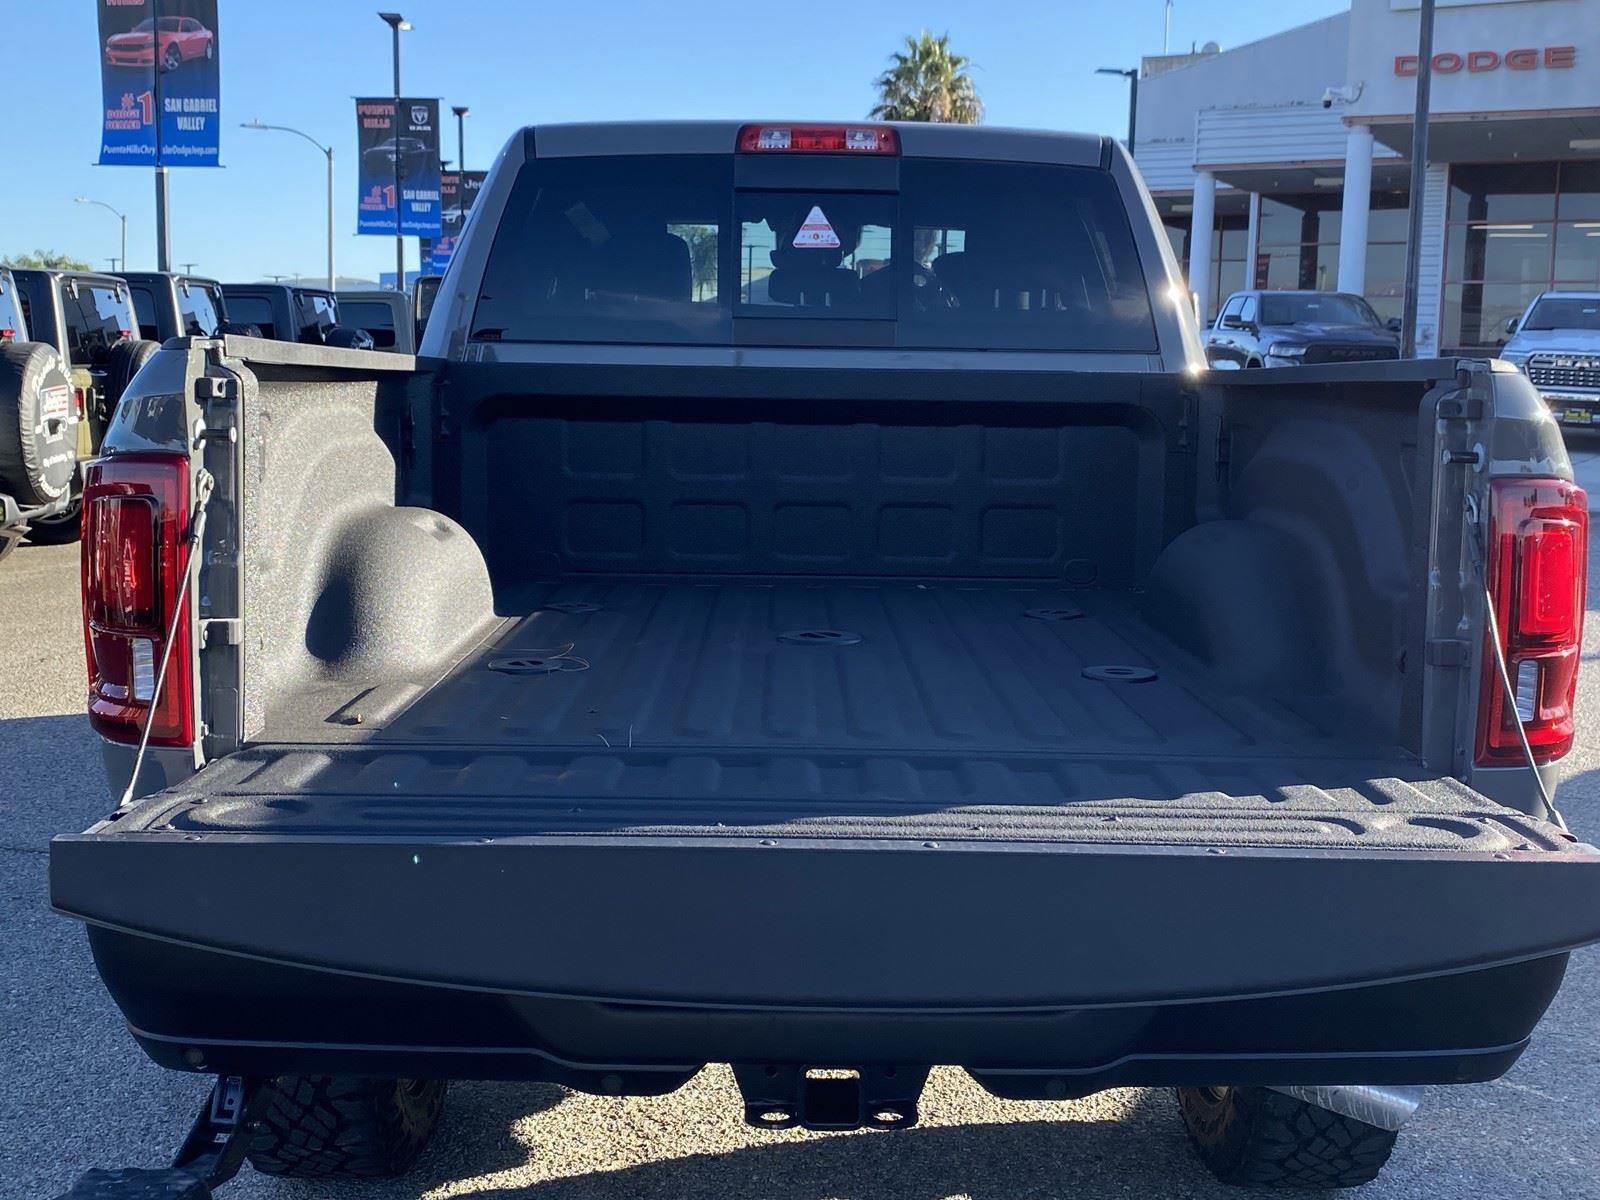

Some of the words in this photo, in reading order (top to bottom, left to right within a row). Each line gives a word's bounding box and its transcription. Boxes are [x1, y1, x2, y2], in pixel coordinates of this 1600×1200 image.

[1394, 46, 1576, 77] DODGE
[164, 98, 182, 112] SAN
[183, 98, 217, 113] GABRIEL
[177, 117, 206, 131] VALLEY
